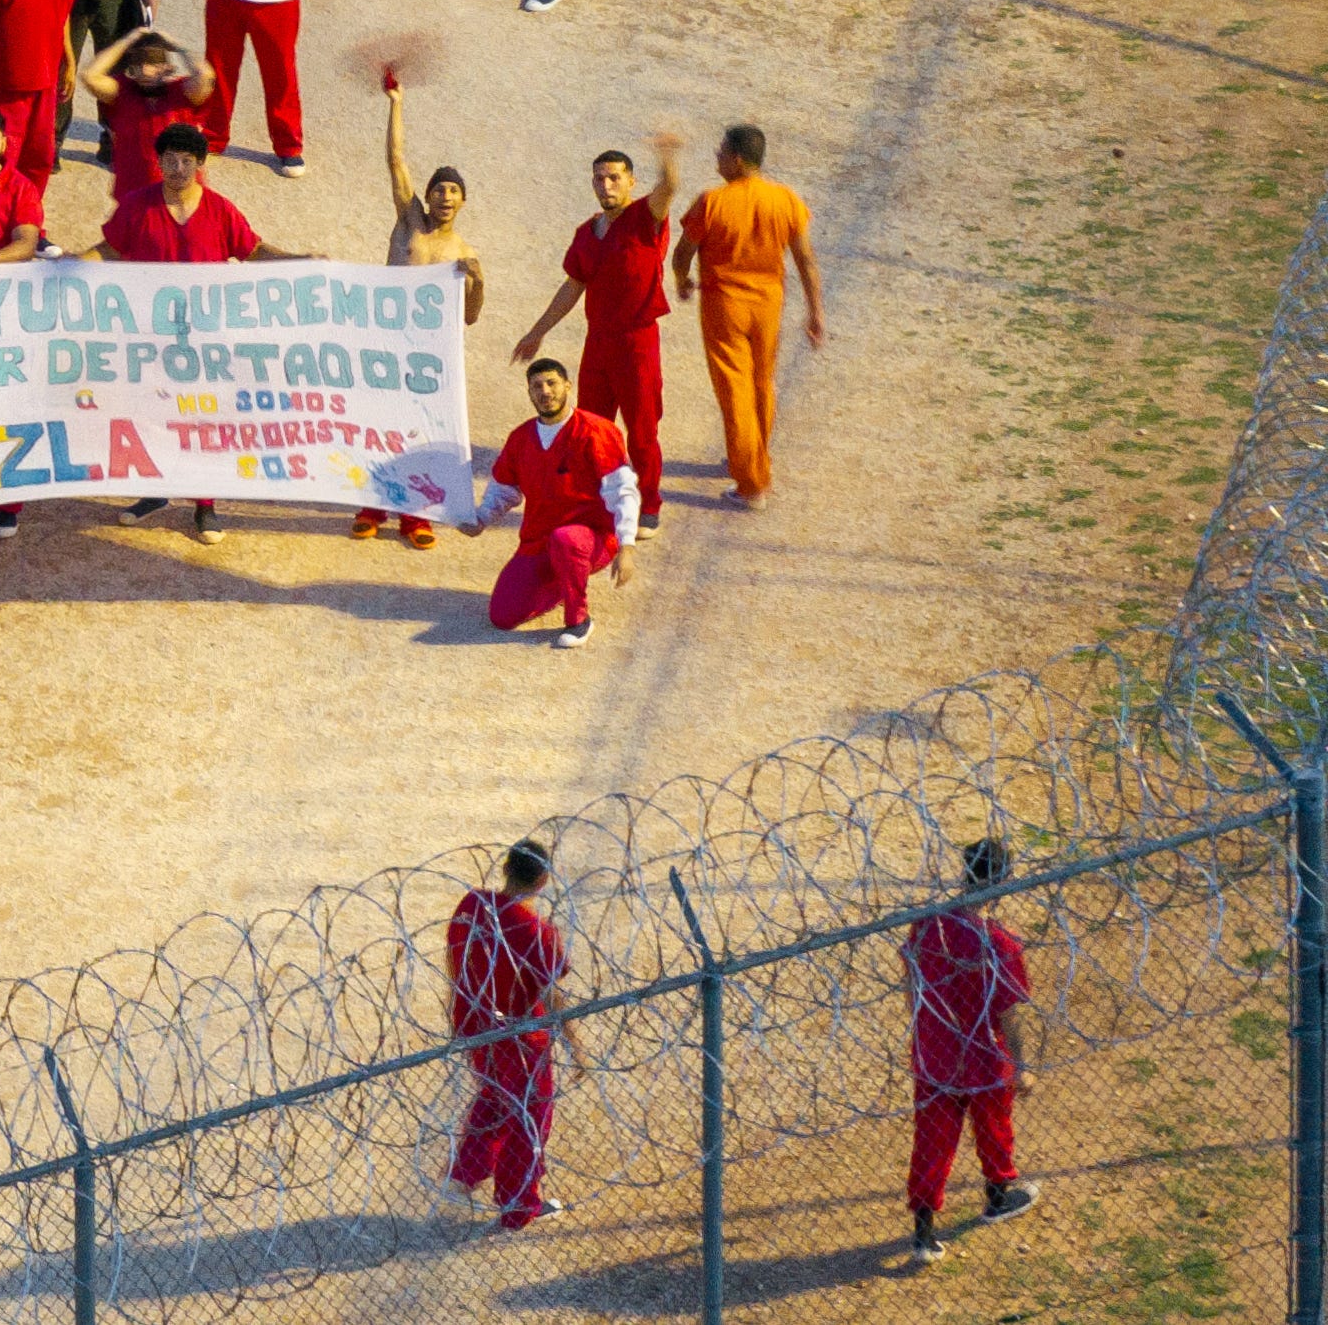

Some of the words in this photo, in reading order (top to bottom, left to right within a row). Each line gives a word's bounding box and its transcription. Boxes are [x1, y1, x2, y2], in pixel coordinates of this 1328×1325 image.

[152, 275, 445, 349] QUEREMOS
[47, 338, 444, 394] DEPORTADOS
[235, 390, 346, 414] SOMOS
